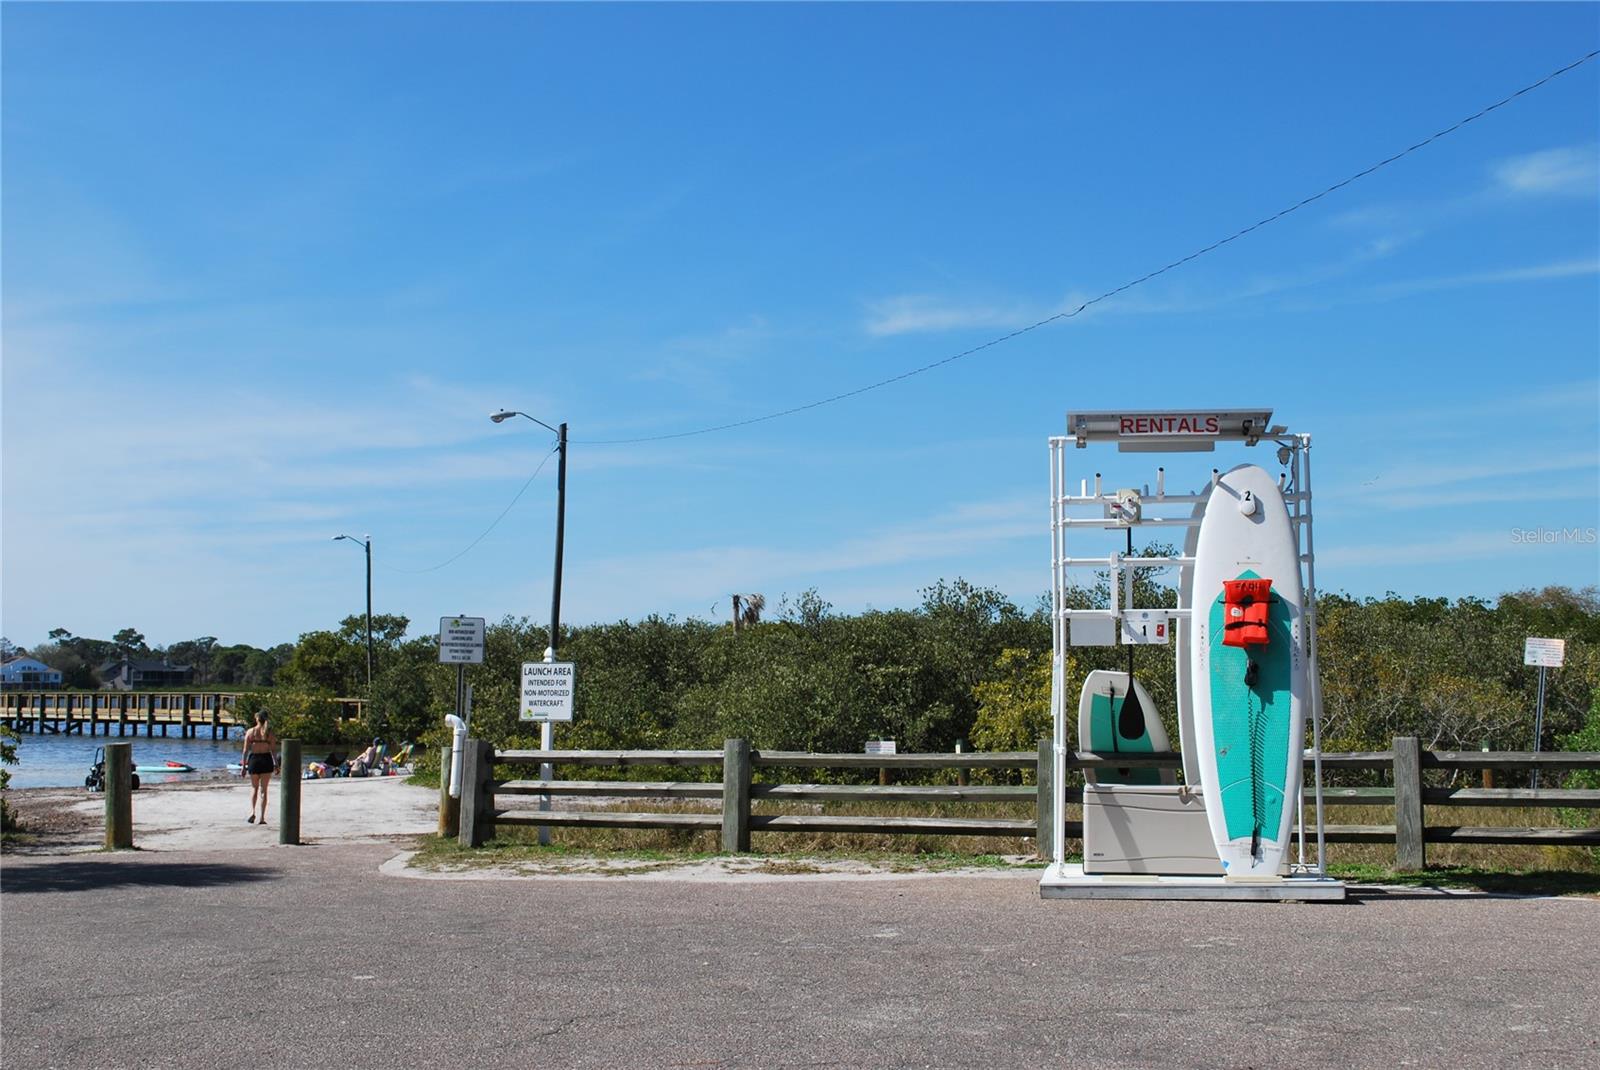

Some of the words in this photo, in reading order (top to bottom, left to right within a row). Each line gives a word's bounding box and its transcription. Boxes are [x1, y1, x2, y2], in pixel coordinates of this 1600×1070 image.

[1120, 417, 1219, 433] RENTALS
[1244, 490, 1251, 501] 2
[1142, 625, 1147, 636] 1
[524, 667, 552, 676] LAUNCH
[553, 667, 572, 676] AREA
[527, 679, 555, 687] INTENDED
[556, 679, 567, 687] FOR
